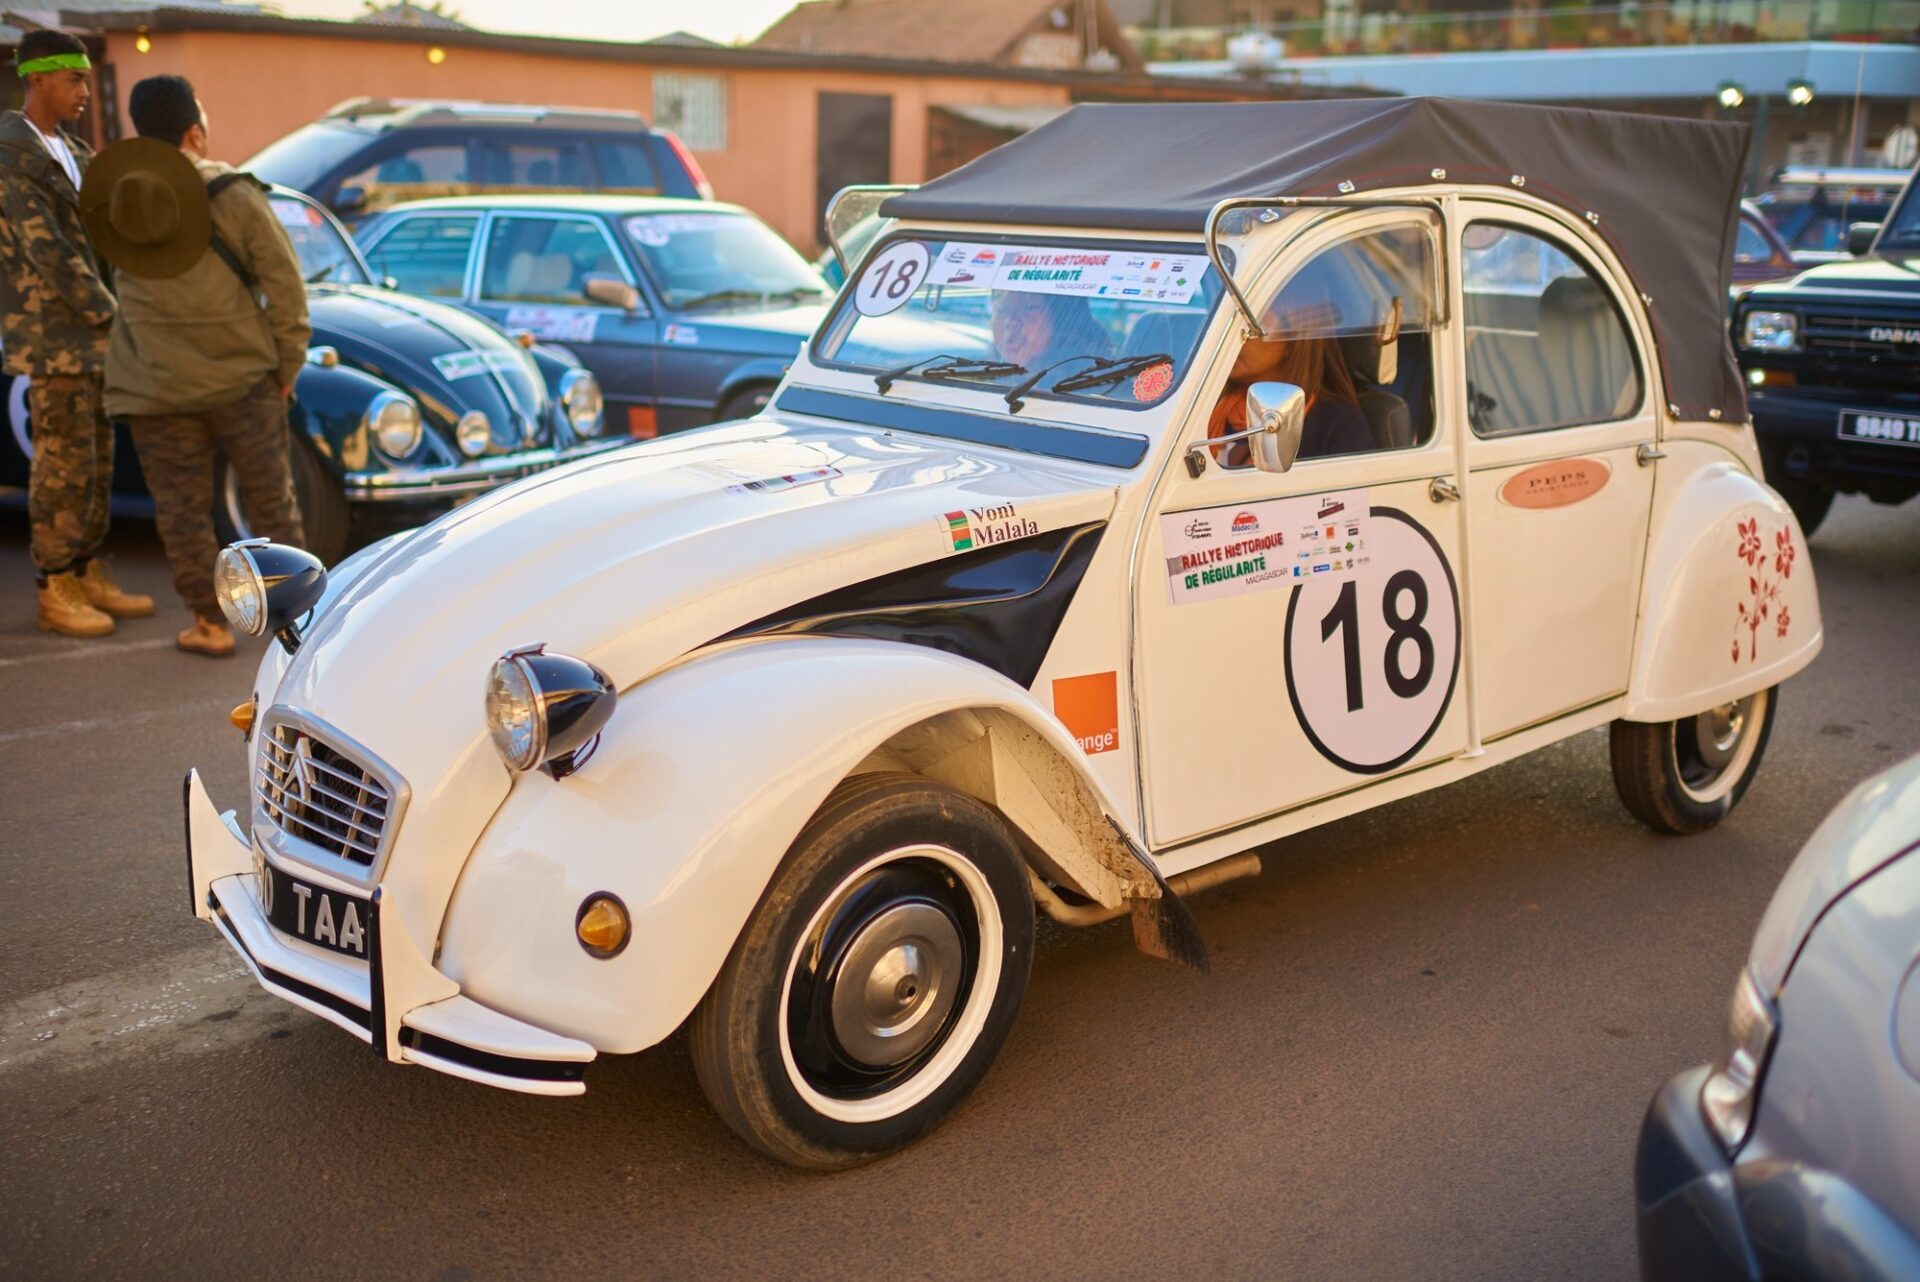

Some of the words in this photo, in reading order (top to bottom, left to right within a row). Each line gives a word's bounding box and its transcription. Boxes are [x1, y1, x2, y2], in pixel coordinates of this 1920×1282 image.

[870, 259, 918, 299] 18
[1008, 269, 1020, 281] DE
[1529, 472, 1586, 488] PEPS
[969, 501, 1017, 524] Voni
[973, 516, 1039, 547] Malala
[1181, 547, 1223, 570] RALLYE
[1184, 573, 1199, 590] DE
[1245, 567, 1288, 585] MADAGASCAR
[1320, 569, 1435, 713] 18
[292, 882, 364, 953] TAA
